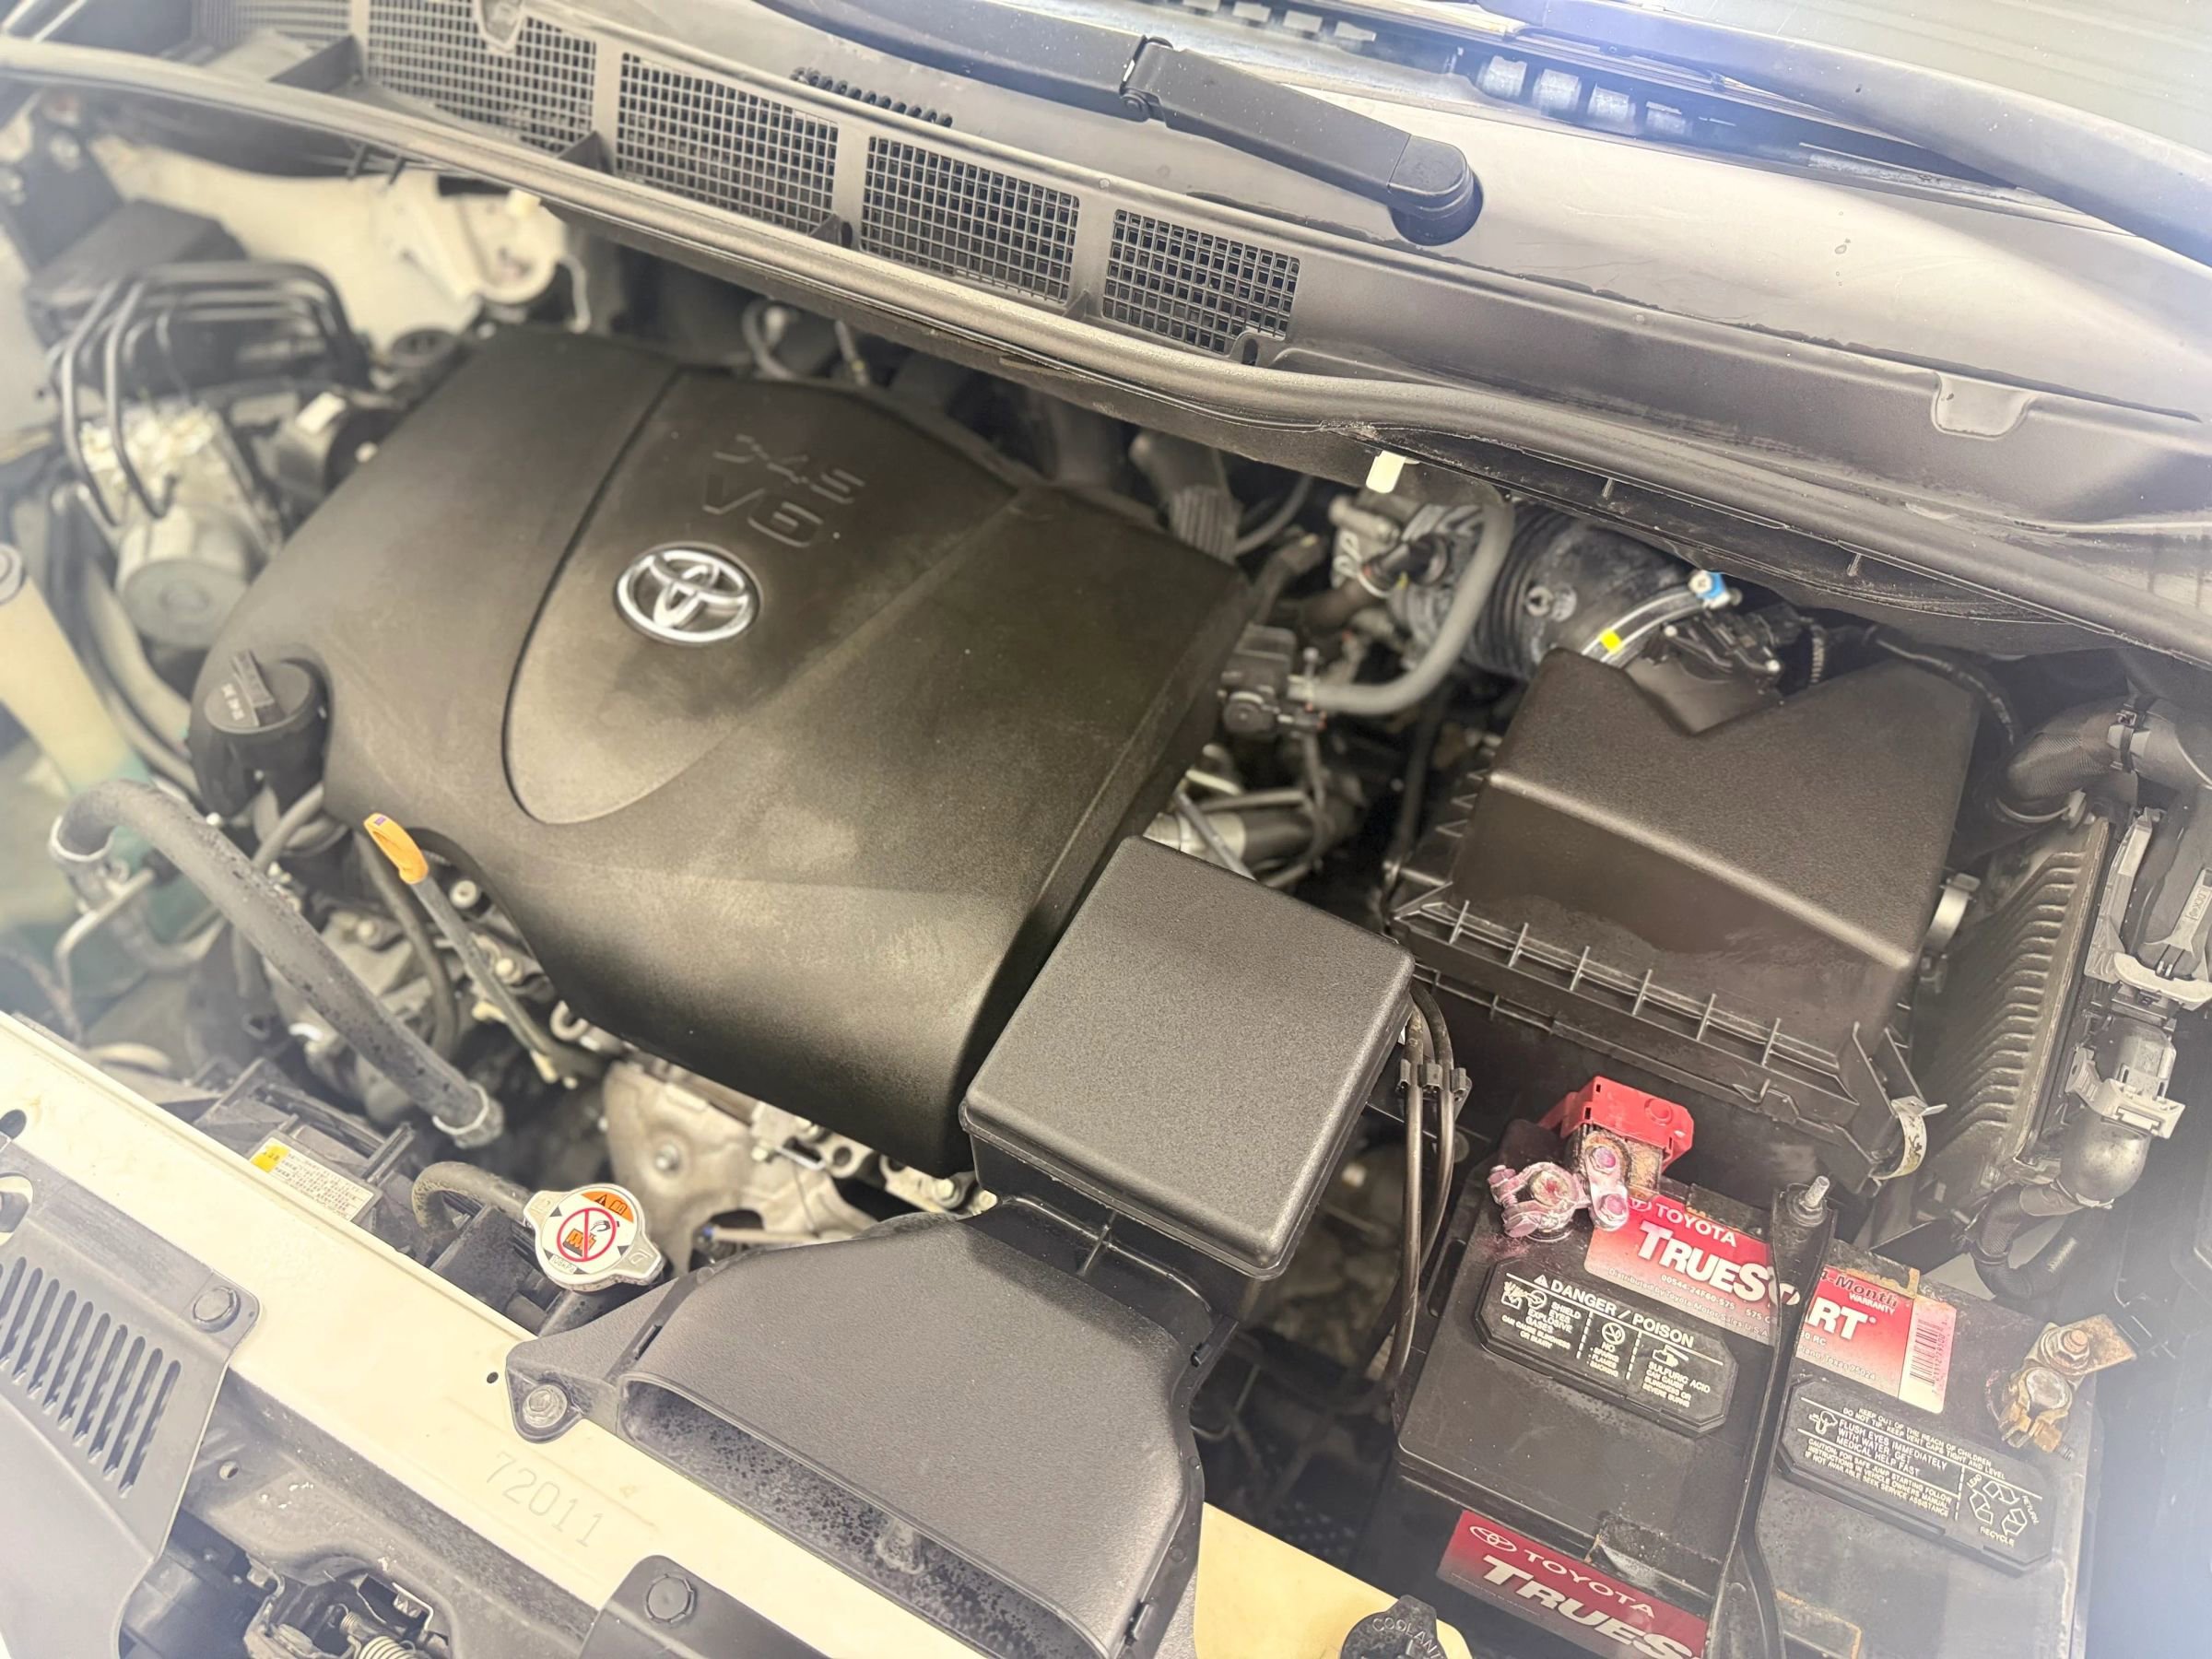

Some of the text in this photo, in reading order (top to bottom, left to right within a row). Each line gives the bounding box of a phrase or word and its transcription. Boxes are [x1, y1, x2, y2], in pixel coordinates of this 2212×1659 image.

[702, 473, 823, 547] V6
[1656, 1203, 1736, 1247] TOYOTA
[1608, 1268, 1654, 1290] Distributed
[1666, 1290, 1691, 1306] Toyota
[1693, 1301, 1720, 1317] Motor
[1849, 1292, 1896, 1316] WARRANTY
[1525, 1316, 1554, 1334] GASES
[1528, 1308, 1573, 1334] EXPLOSIVE
[1549, 1309, 1571, 1324] EYES
[1551, 1301, 1582, 1319] SHIELD
[1551, 1279, 1618, 1316] DANGER
[1632, 1313, 1694, 1348] POISON
[1746, 1309, 1762, 1322] 575
[1501, 1314, 1571, 1349] CAN CAUSE BLINDNESS
[1520, 1330, 1530, 1339] OR
[1601, 1341, 1616, 1353] NO
[1590, 1360, 1618, 1378] SMOKING
[1592, 1353, 1618, 1370] FLAMES
[1649, 1361, 1711, 1394] SULFURIC ACID
[1642, 1383, 1667, 1398] SEVERE
[1644, 1376, 1691, 1401] BLINDNESS OR
[1646, 1370, 1684, 1391] CAN CAUSE
[1838, 1428, 1859, 1442] WITH
[1894, 1451, 1911, 1465] GET
[1839, 1419, 1947, 1472] FLUSH EYES IMMEDIATELY
[1843, 1407, 1853, 1417] DO
[1854, 1413, 1869, 1423] NOT
[1887, 1426, 1904, 1437] KEEP
[1906, 1433, 1924, 1445] VENT
[1925, 1442, 1945, 1454] CAPS
[1946, 1450, 1967, 1464] TIGHT
[1968, 1459, 1983, 1470] AND
[1984, 1465, 2006, 1480] LEVEL
[1859, 1408, 1992, 1467] KEEP OUT OF THE REACH OF CHILDREN
[1807, 1445, 1853, 1469] INSTRUCTIONS
[1855, 1465, 1863, 1473] IN
[1864, 1468, 1890, 1485] VEHICLE
[1891, 1480, 1920, 1499] OWNERS
[1836, 1436, 1921, 1477] MEDICAL HELP FAST
[1805, 1450, 1948, 1517] IF NOT AVAILABLE SEEK SERVICE ASSISTANCE
[1839, 1451, 1853, 1462] FOR
[1854, 1457, 1871, 1469] SAFE
[1872, 1465, 1890, 1477] JUMP
[1891, 1474, 1924, 1492] STARTING
[1924, 1485, 1952, 1504] FOLLOW
[1967, 1474, 1983, 1488] LEAD
[487, 1451, 604, 1547] 72011
[2022, 1495, 2039, 1524] RETURN
[1980, 1526, 2015, 1547] RECYCLE
[1524, 1549, 1655, 1618] TOYOTA
[1483, 1555, 1703, 1659] TRUES
